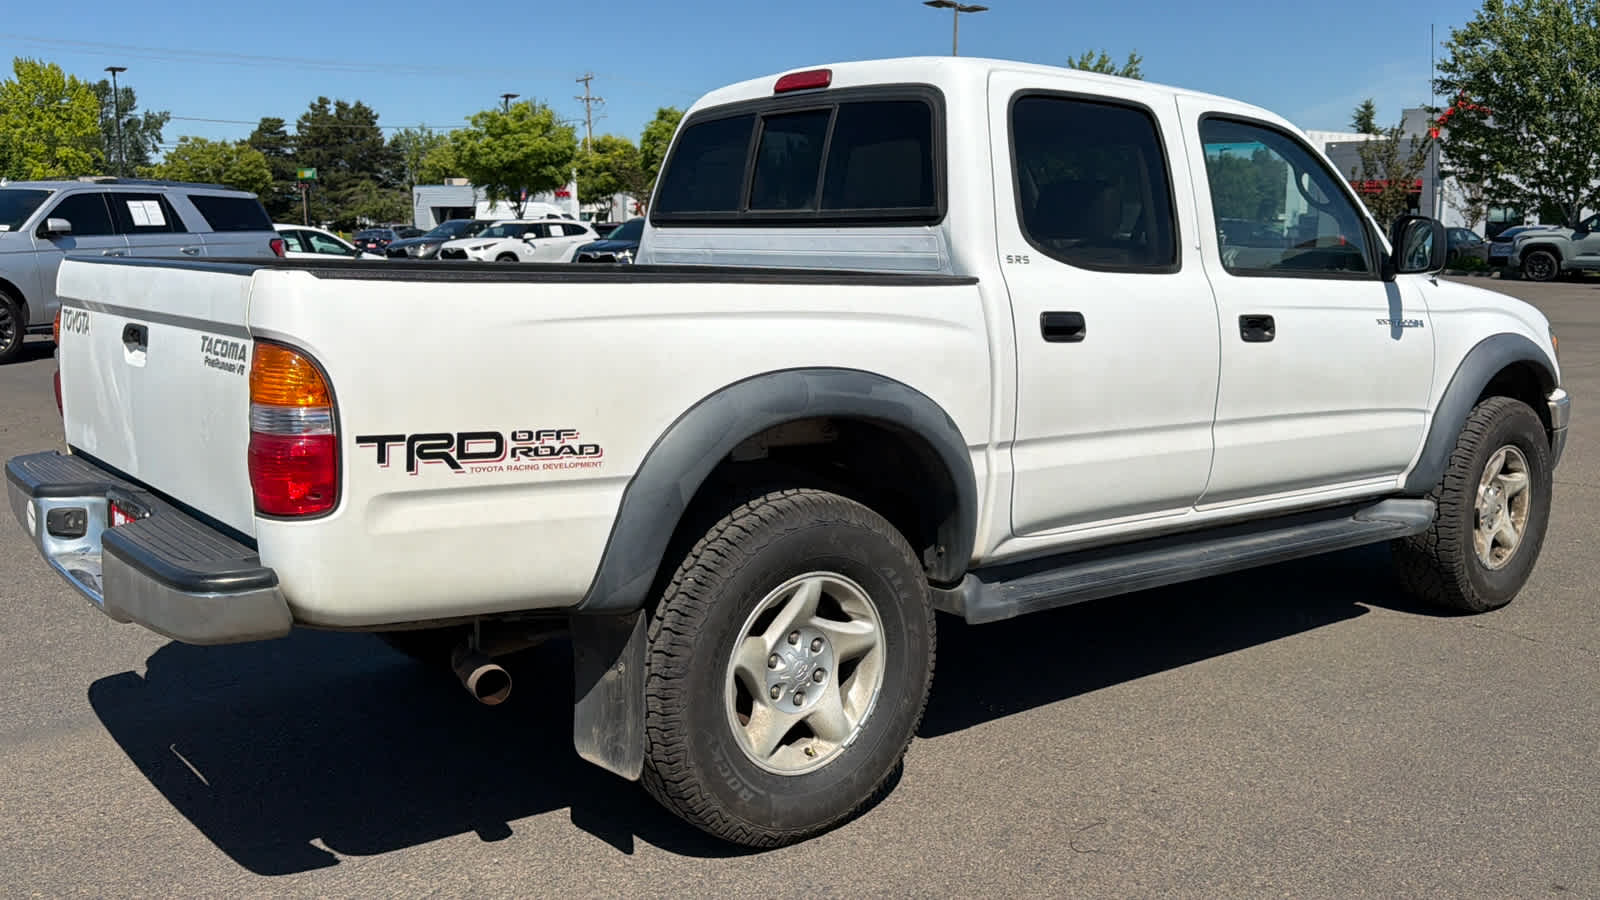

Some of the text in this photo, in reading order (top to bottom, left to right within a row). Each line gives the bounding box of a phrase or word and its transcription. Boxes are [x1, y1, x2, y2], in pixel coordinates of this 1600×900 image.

[63, 309, 91, 336] TOYOTA
[201, 336, 246, 362] TACOMA
[511, 428, 580, 444] OFF
[355, 431, 507, 475] TRD
[511, 444, 603, 461] ROAD
[470, 461, 602, 473] TOYOTA RACING DEVELOPMENT
